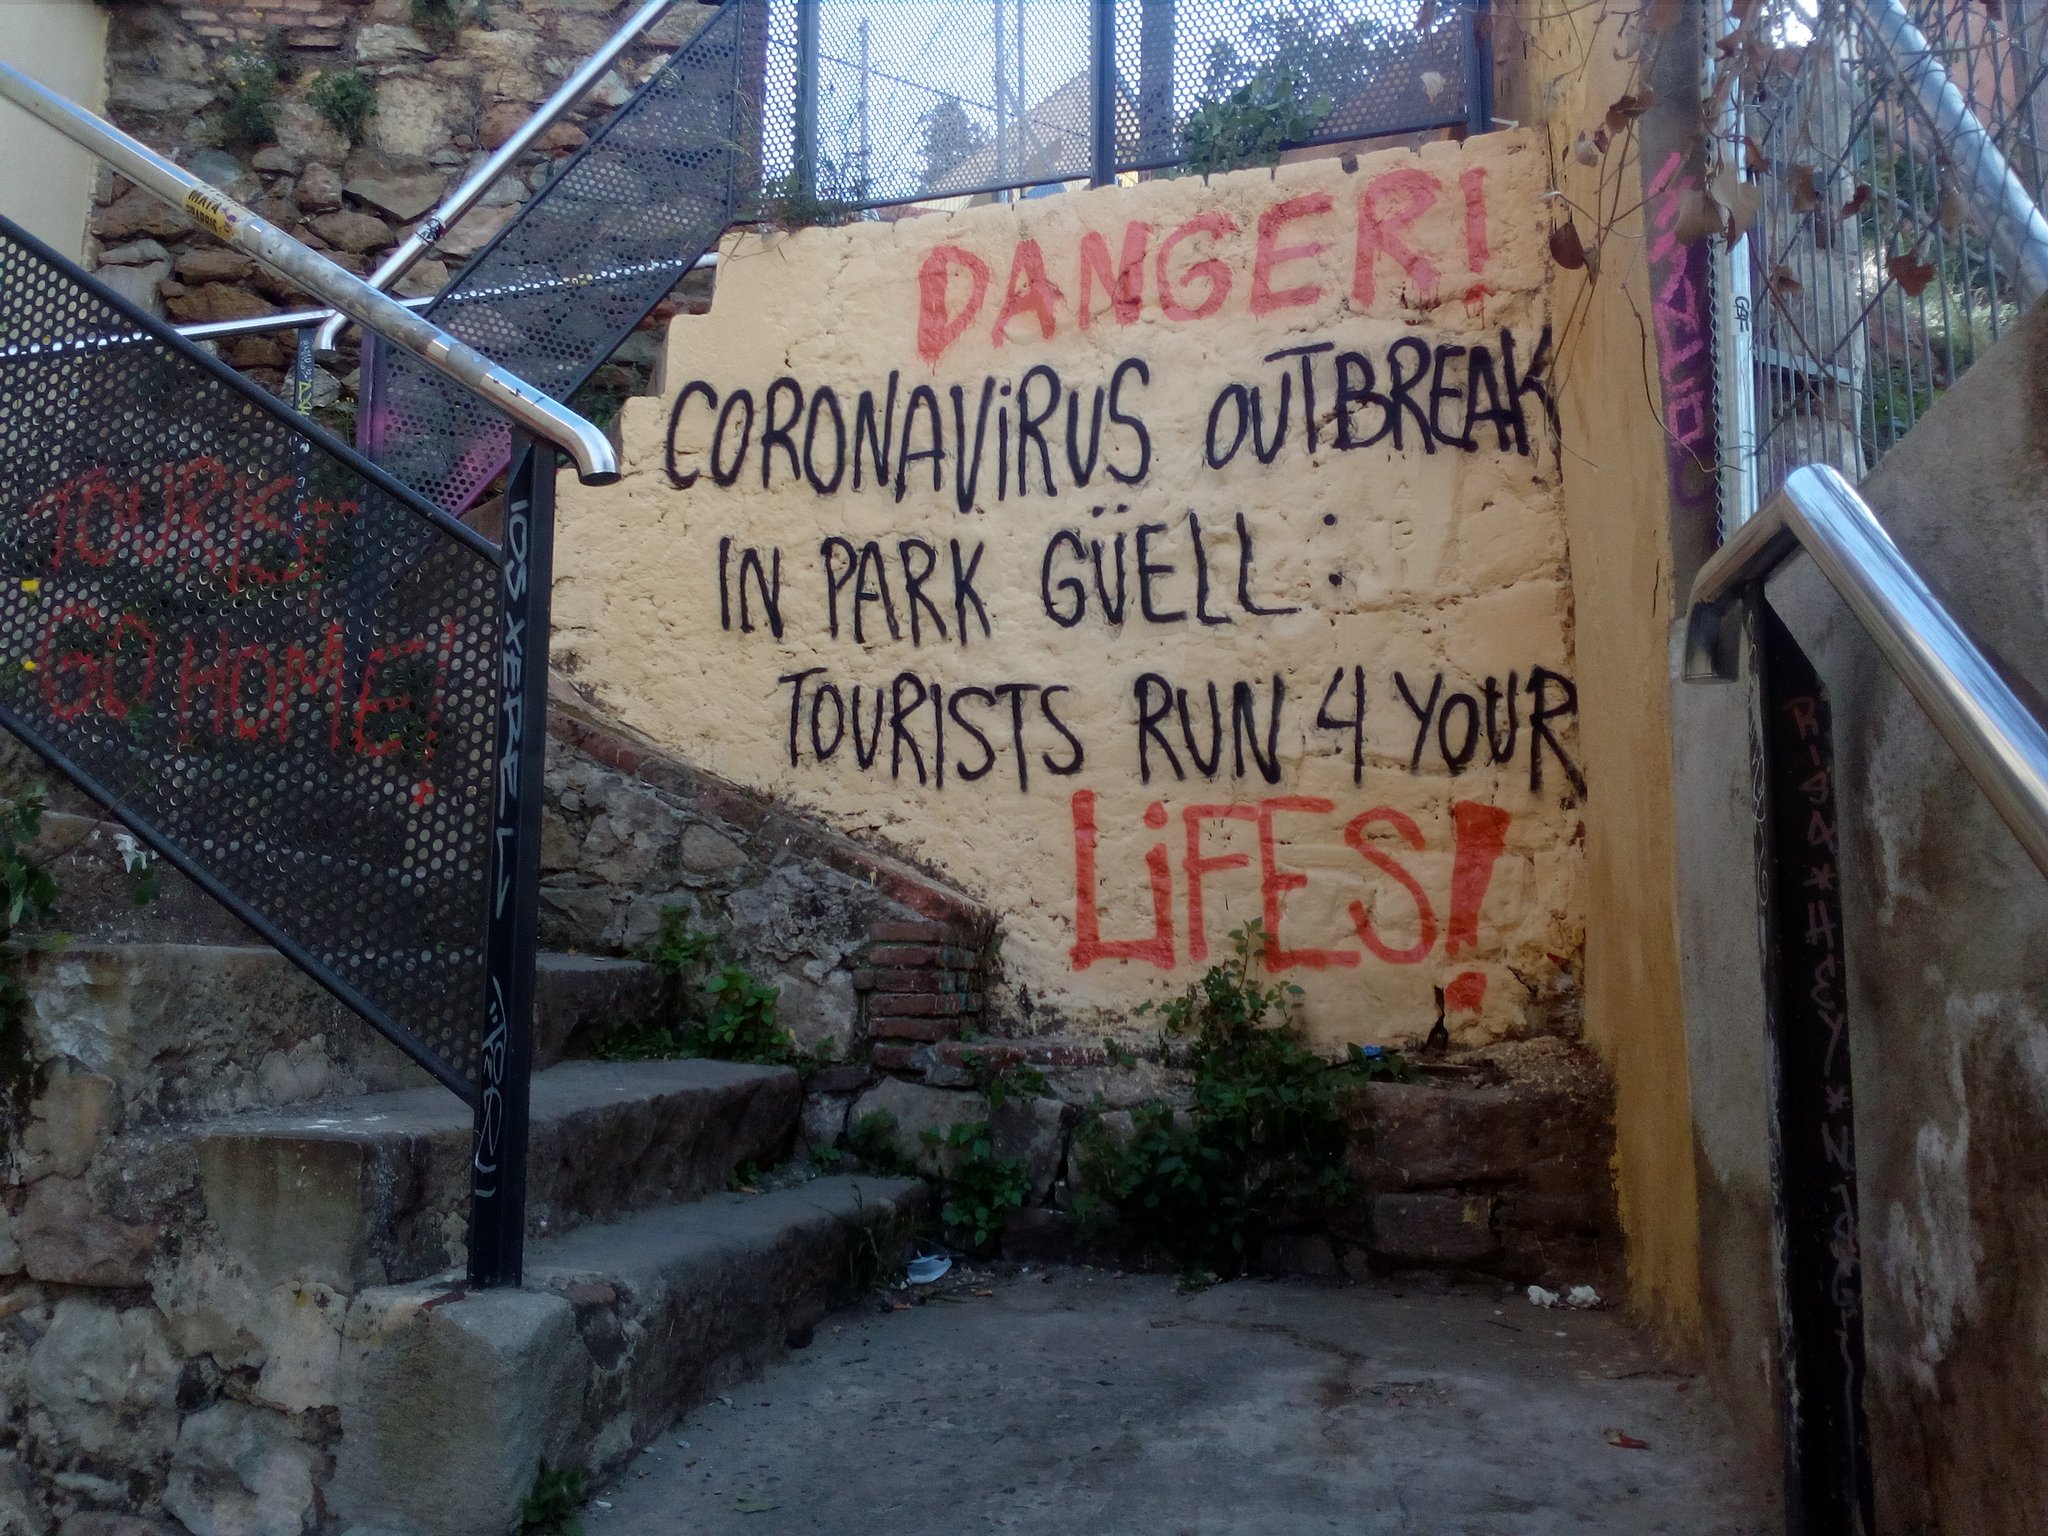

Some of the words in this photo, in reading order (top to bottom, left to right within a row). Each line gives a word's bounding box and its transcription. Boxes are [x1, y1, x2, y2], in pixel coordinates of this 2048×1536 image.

[916, 167, 1491, 367] DANGER!
[1205, 323, 1562, 470] OUTBREAK
[719, 536, 784, 639] IN
[820, 536, 992, 646] PARK
[38, 602, 157, 722] GO
[778, 667, 1086, 793] TOURISTS
[1133, 671, 1285, 785] RUN
[1315, 664, 1367, 788] 4
[1393, 664, 1589, 800] YOUR
